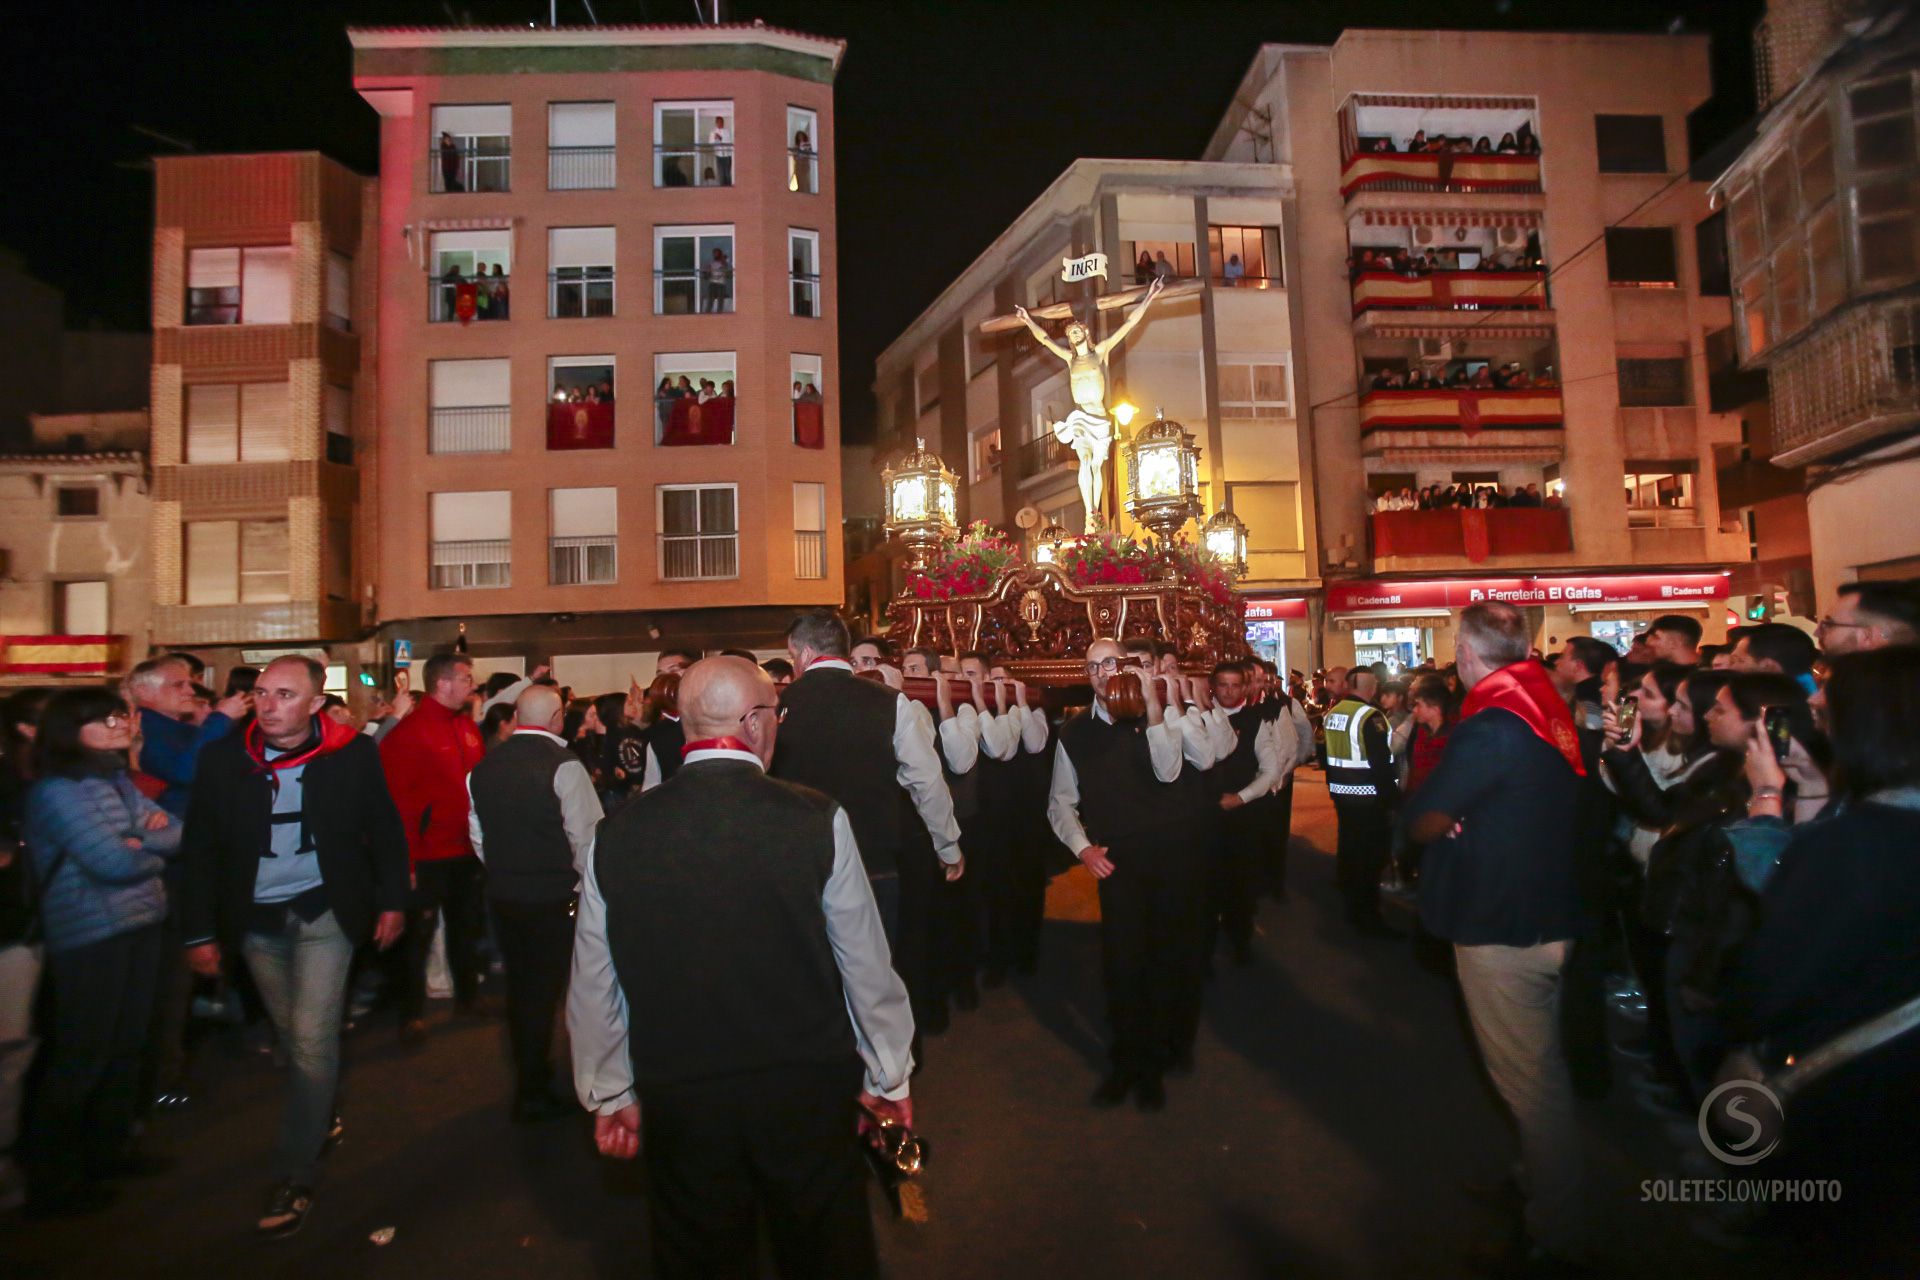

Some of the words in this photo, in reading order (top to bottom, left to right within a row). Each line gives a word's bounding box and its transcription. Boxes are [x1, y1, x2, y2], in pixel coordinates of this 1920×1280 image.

[1071, 258, 1098, 276] INRI
[1488, 588, 1545, 601] Ferretería
[1549, 587, 1562, 600] El
[1565, 587, 1602, 599] Gafas
[1673, 587, 1701, 595] Cadena
[1703, 586, 1715, 594] 88
[1357, 596, 1390, 605] Cadena
[1391, 596, 1401, 604] 88
